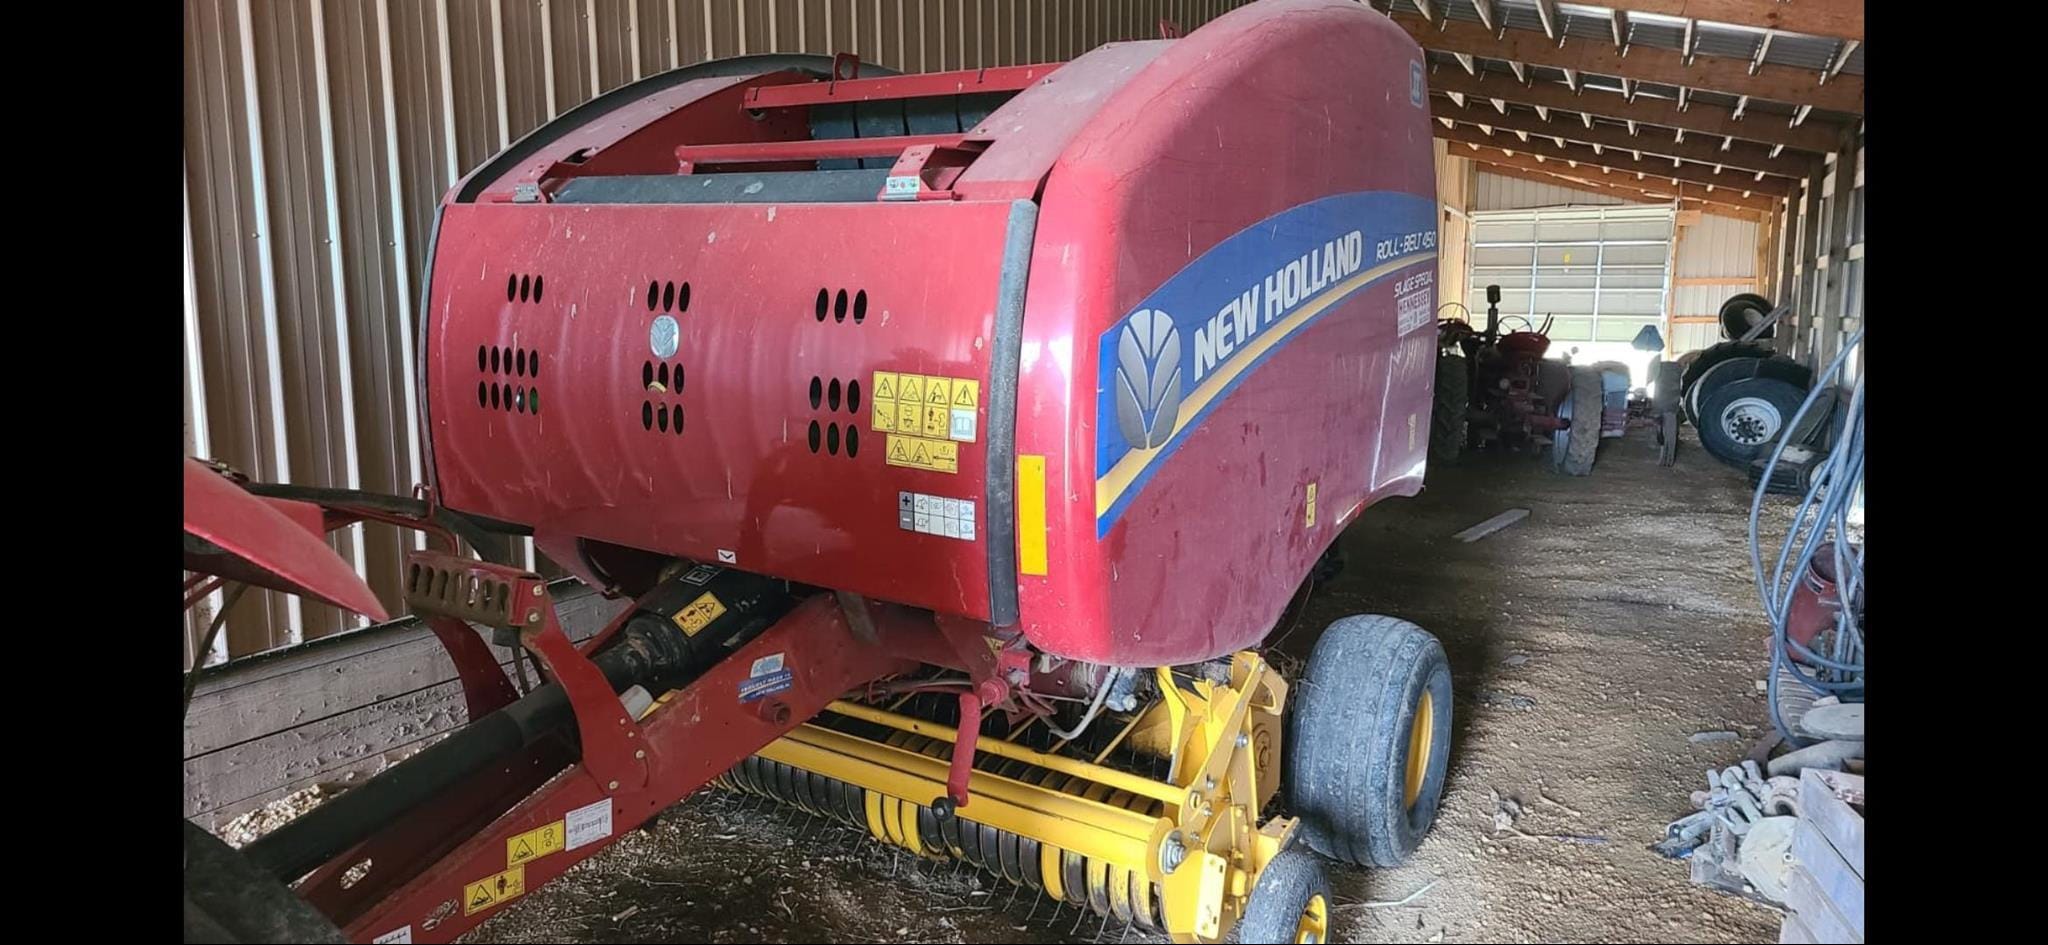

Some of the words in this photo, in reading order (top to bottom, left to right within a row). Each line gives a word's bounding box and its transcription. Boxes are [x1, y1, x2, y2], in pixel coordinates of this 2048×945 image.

[1422, 230, 1437, 249] 450
[1194, 283, 1260, 382] NEW
[1264, 230, 1362, 324] HOLLAND
